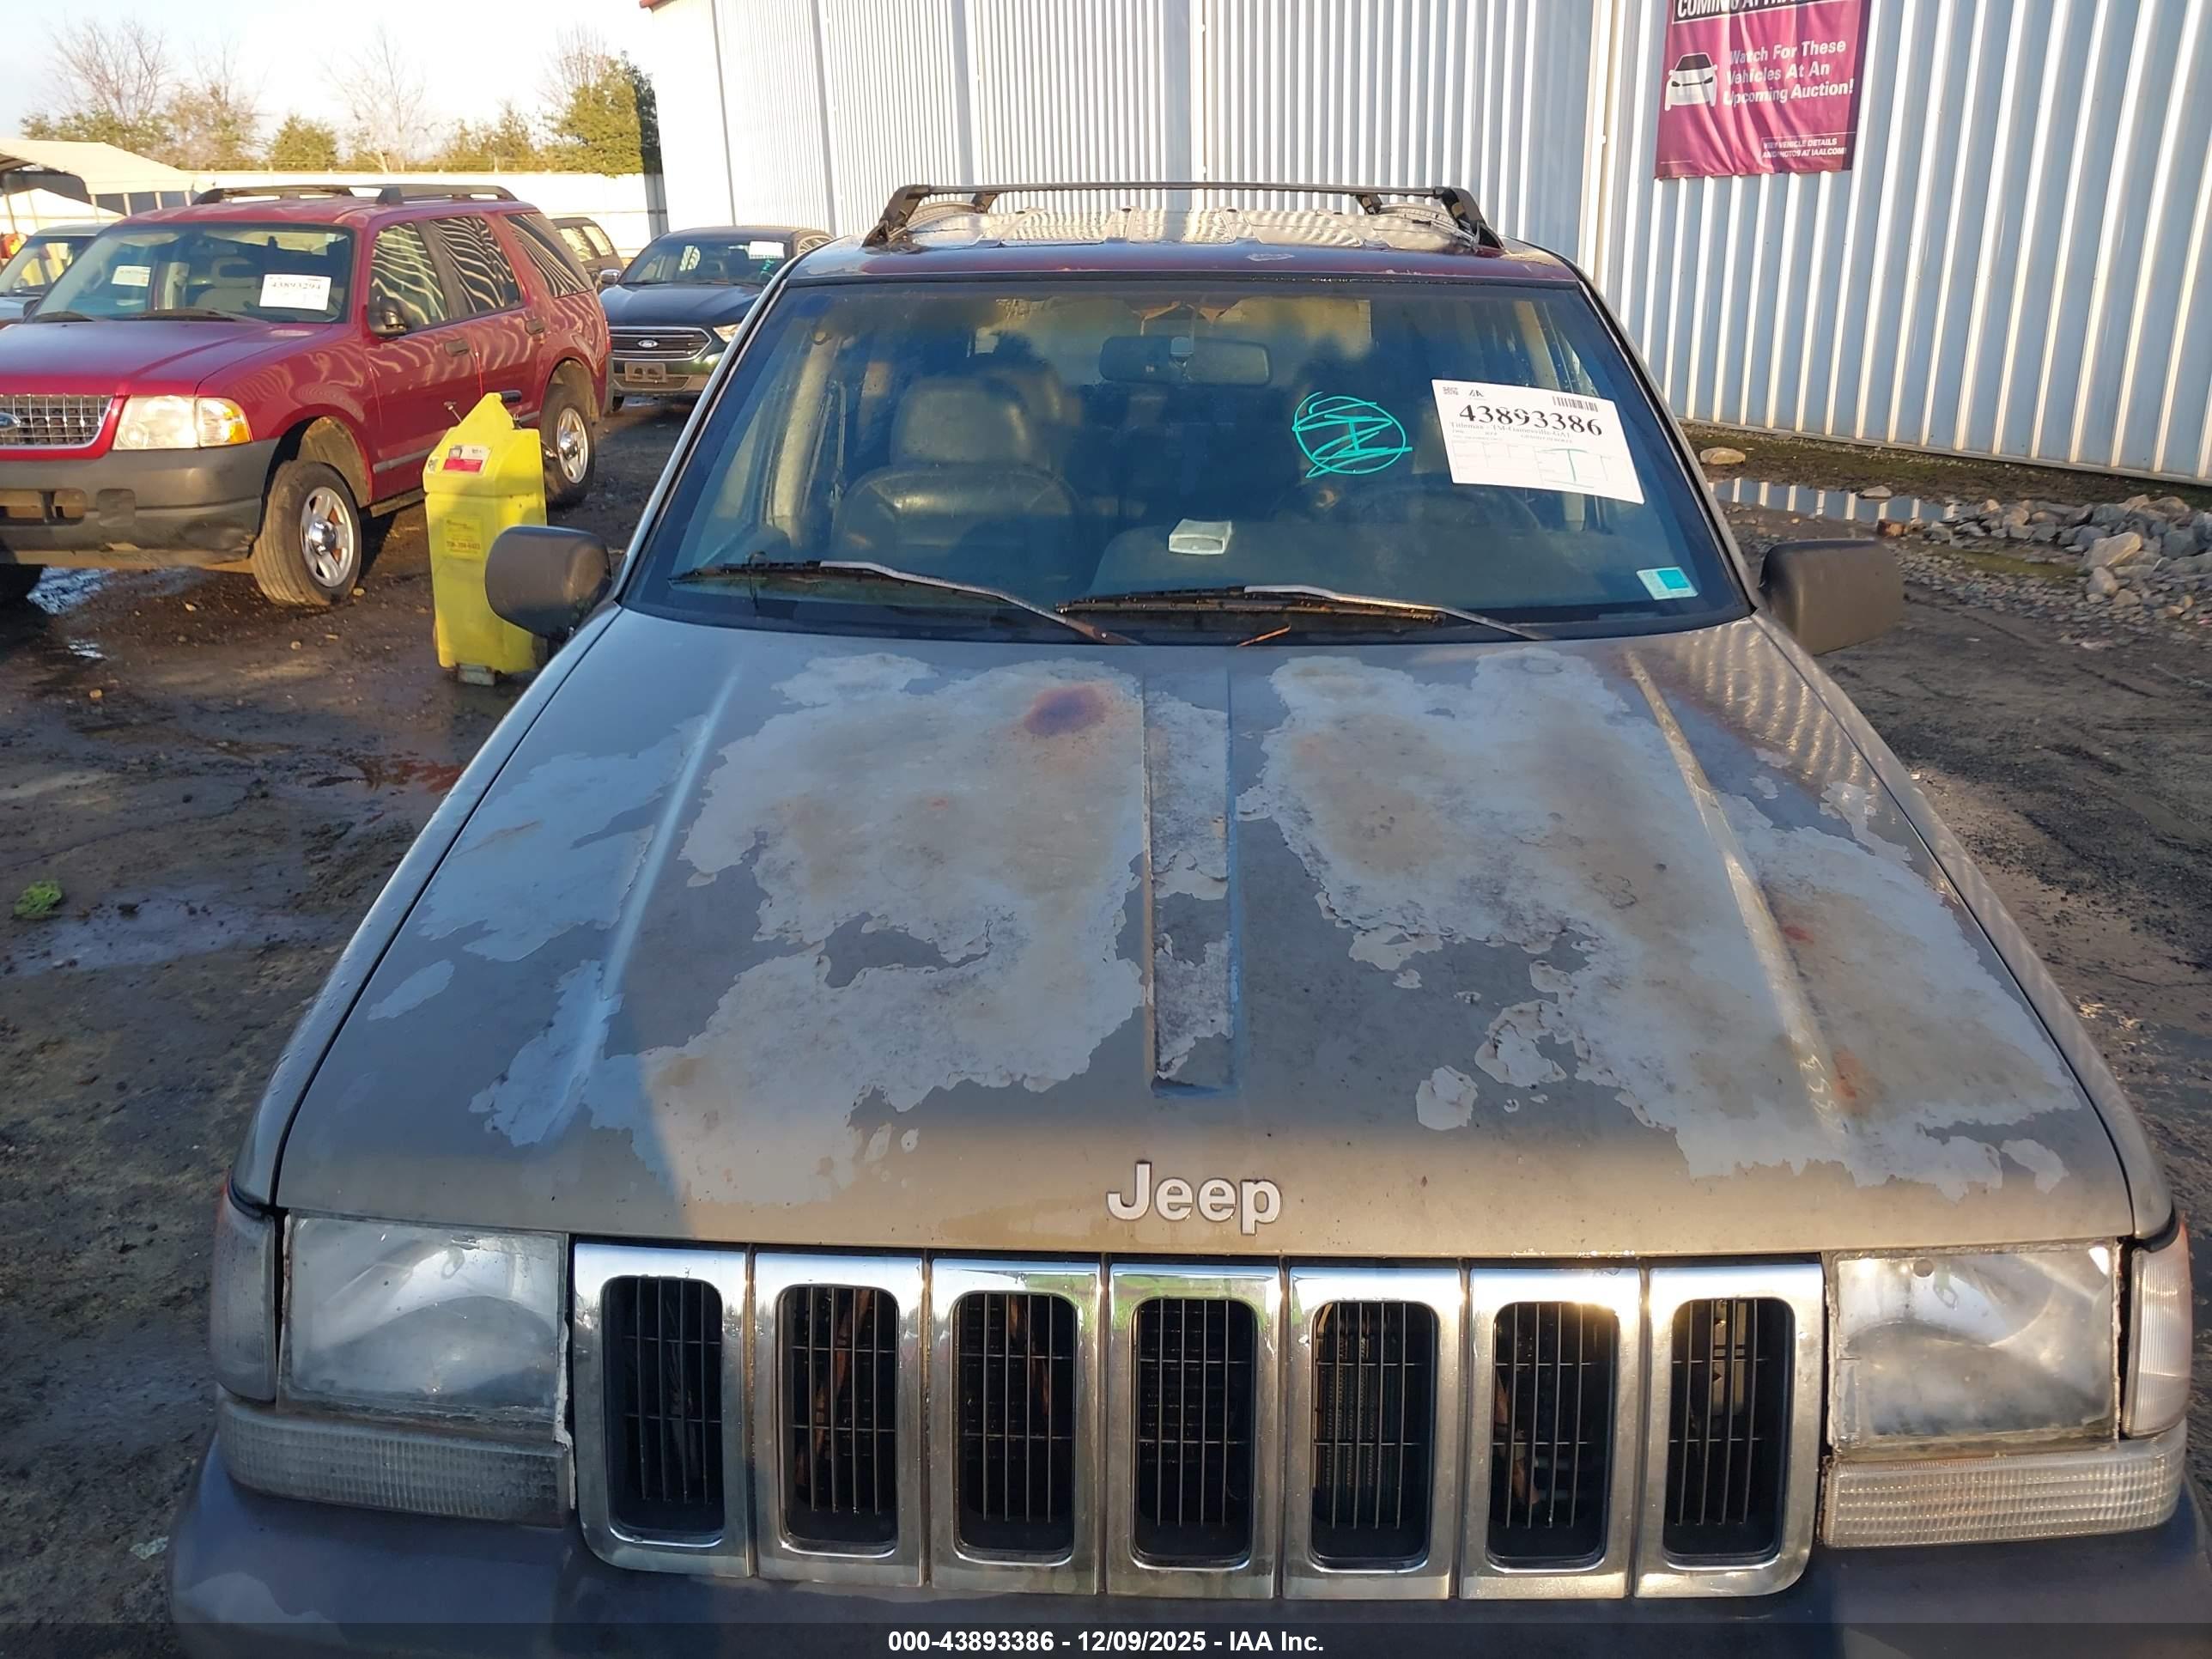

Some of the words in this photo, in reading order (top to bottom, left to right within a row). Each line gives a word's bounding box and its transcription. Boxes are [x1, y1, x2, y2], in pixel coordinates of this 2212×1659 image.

[1729, 46, 1769, 64] Watch
[1772, 44, 1797, 59] For
[1802, 40, 1846, 58] These
[1727, 67, 1781, 85] Vehicles
[1785, 65, 1804, 79] At
[1808, 62, 1831, 76] An
[1723, 88, 1789, 107] Upcoming
[1790, 78, 1855, 100] Auction!
[1459, 404, 1603, 437] 43893386
[1106, 1160, 1283, 1237] Jeep
